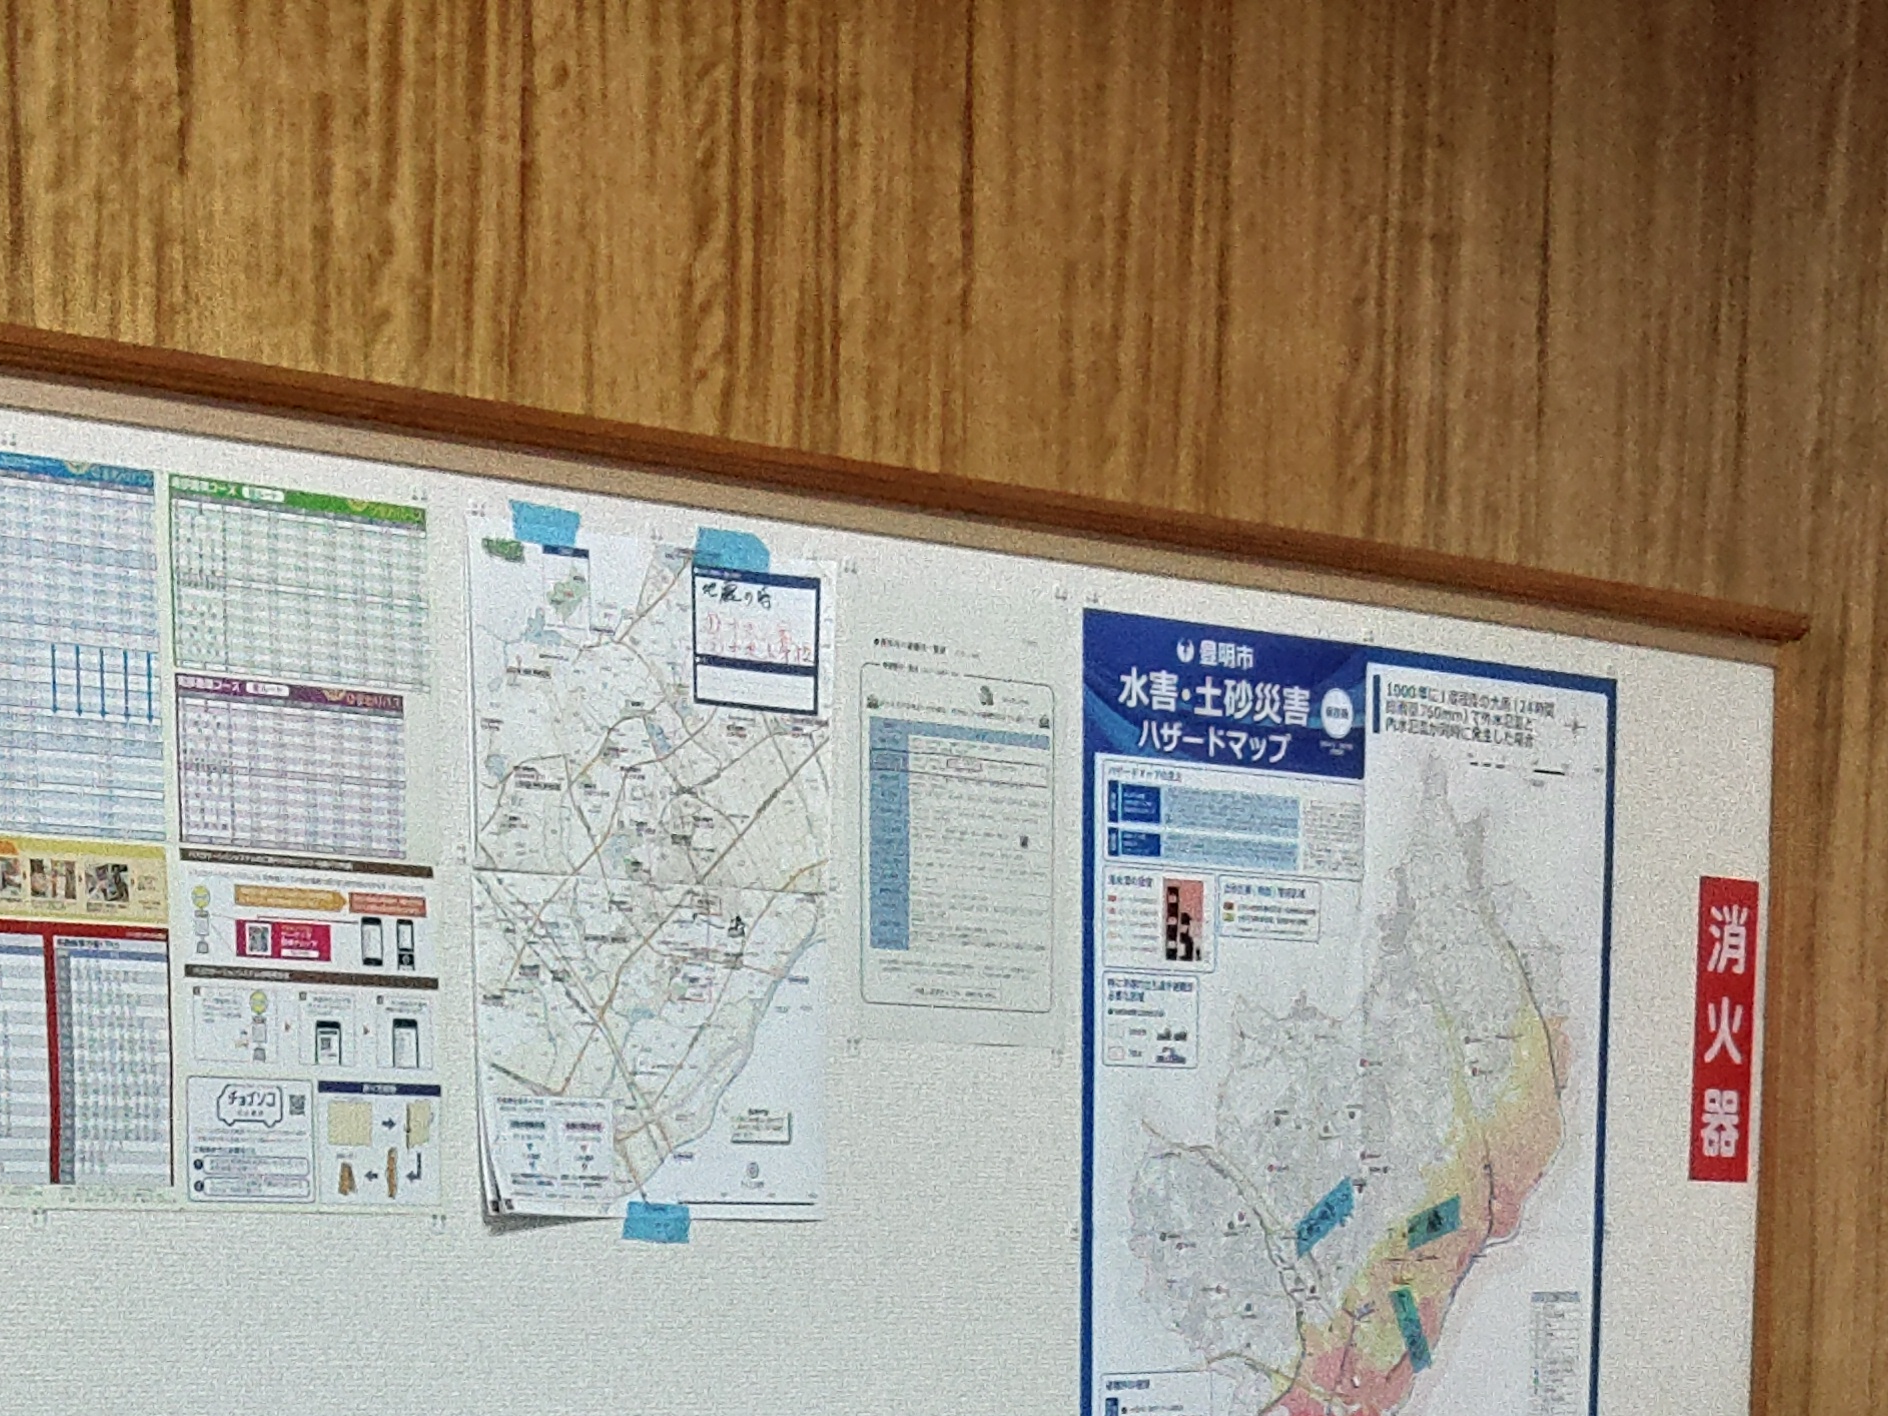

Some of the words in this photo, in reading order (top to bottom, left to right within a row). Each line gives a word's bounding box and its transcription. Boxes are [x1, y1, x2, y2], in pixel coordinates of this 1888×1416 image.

[1199, 639, 1254, 671] 豊明市
[1118, 665, 1311, 727] 水害・土砂災害
[1138, 719, 1292, 763] ハザードマップ
[1701, 904, 1749, 1158] 消火器
[228, 1091, 276, 1107] チョイソコ
